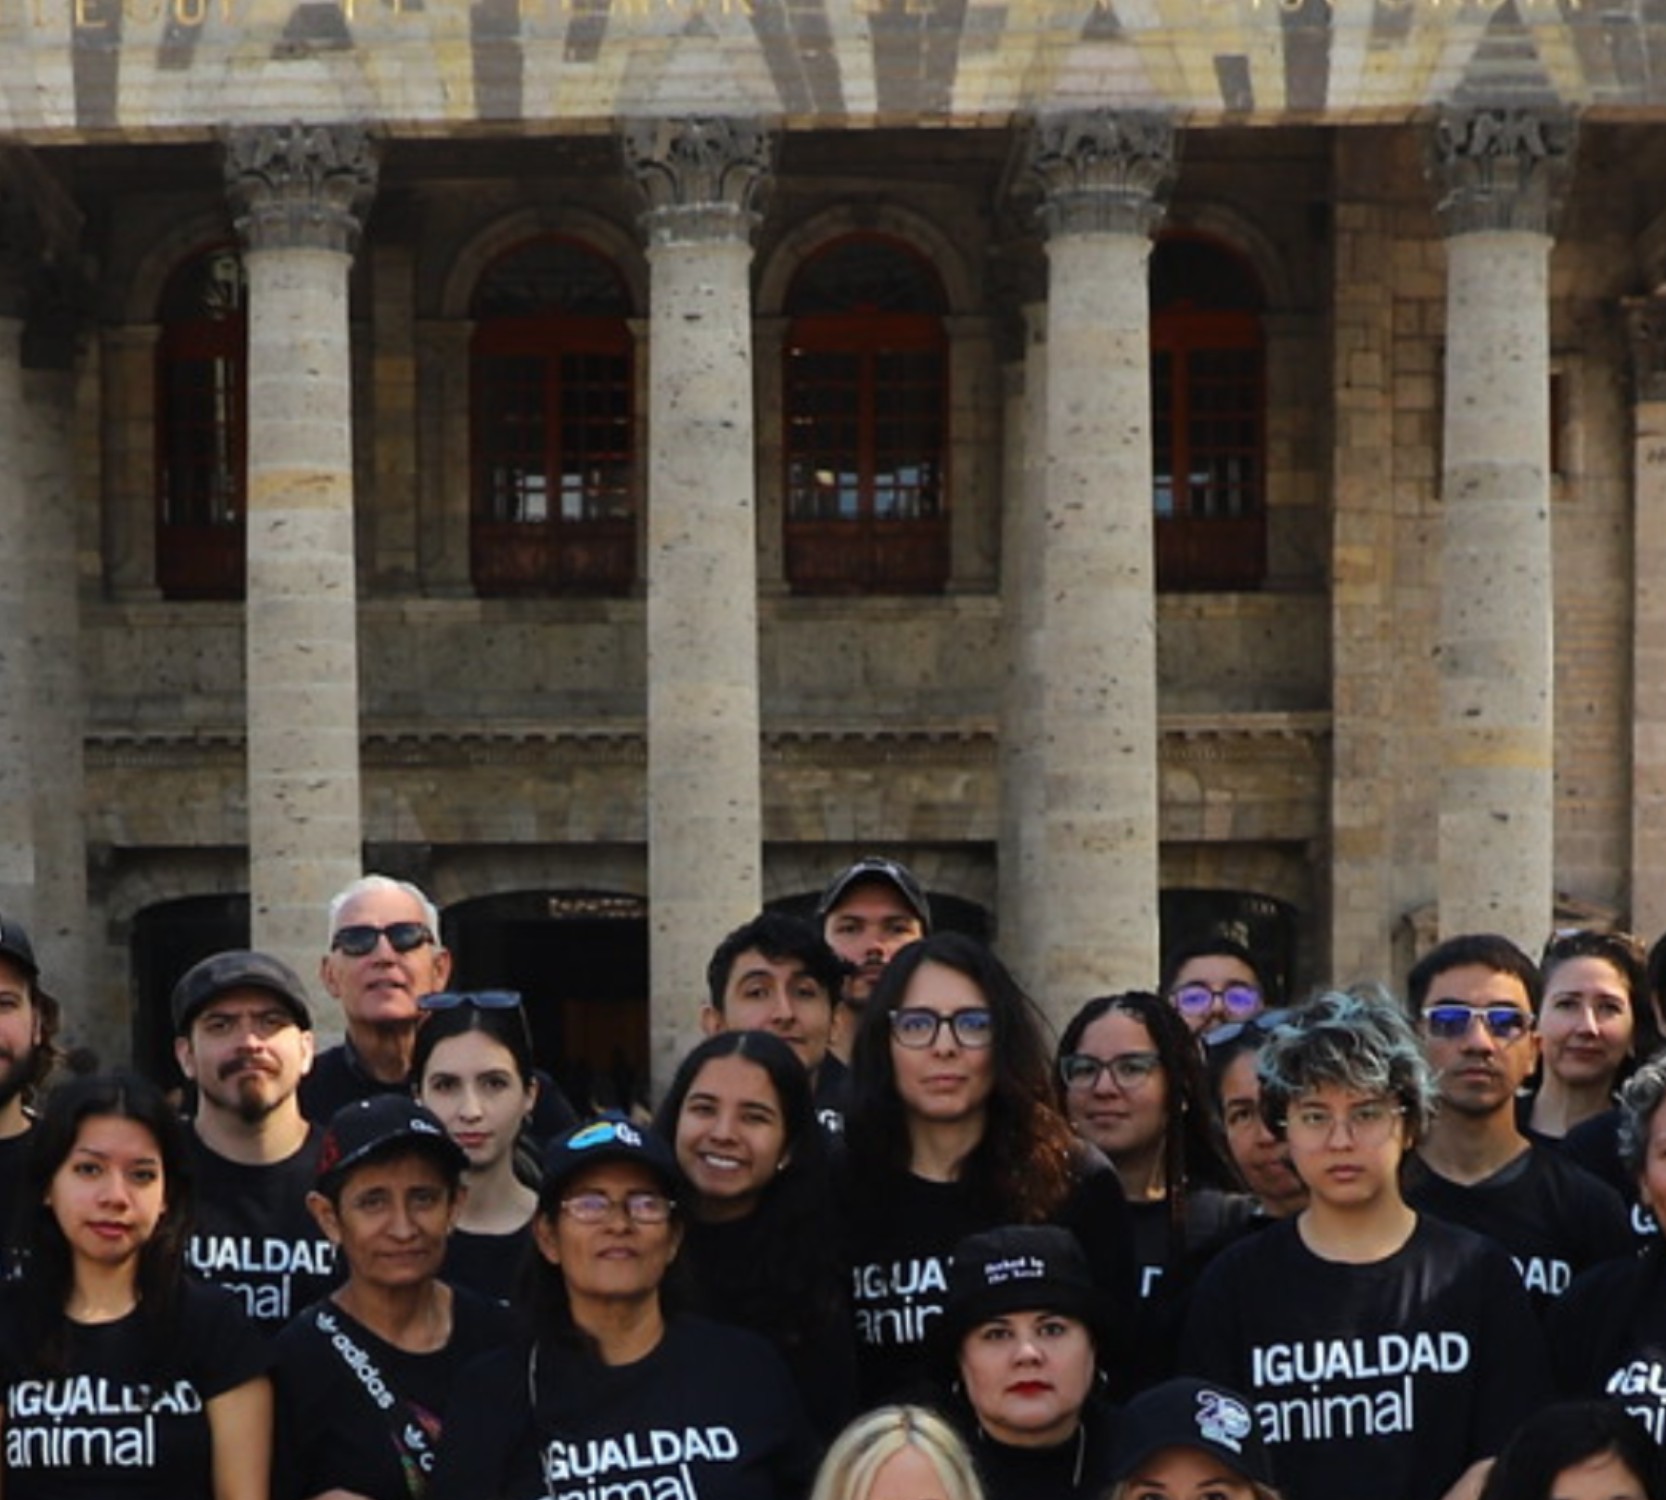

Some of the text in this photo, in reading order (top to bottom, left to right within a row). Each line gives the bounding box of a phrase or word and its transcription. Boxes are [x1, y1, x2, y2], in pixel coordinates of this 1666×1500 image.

[186, 1236, 335, 1275] UALDAD
[853, 1256, 954, 1299] IGUA
[331, 1332, 395, 1410] adidas
[1253, 1331, 1470, 1387] IGUALDAD
[1255, 1375, 1414, 1445] animal
[6, 1414, 155, 1467] animal
